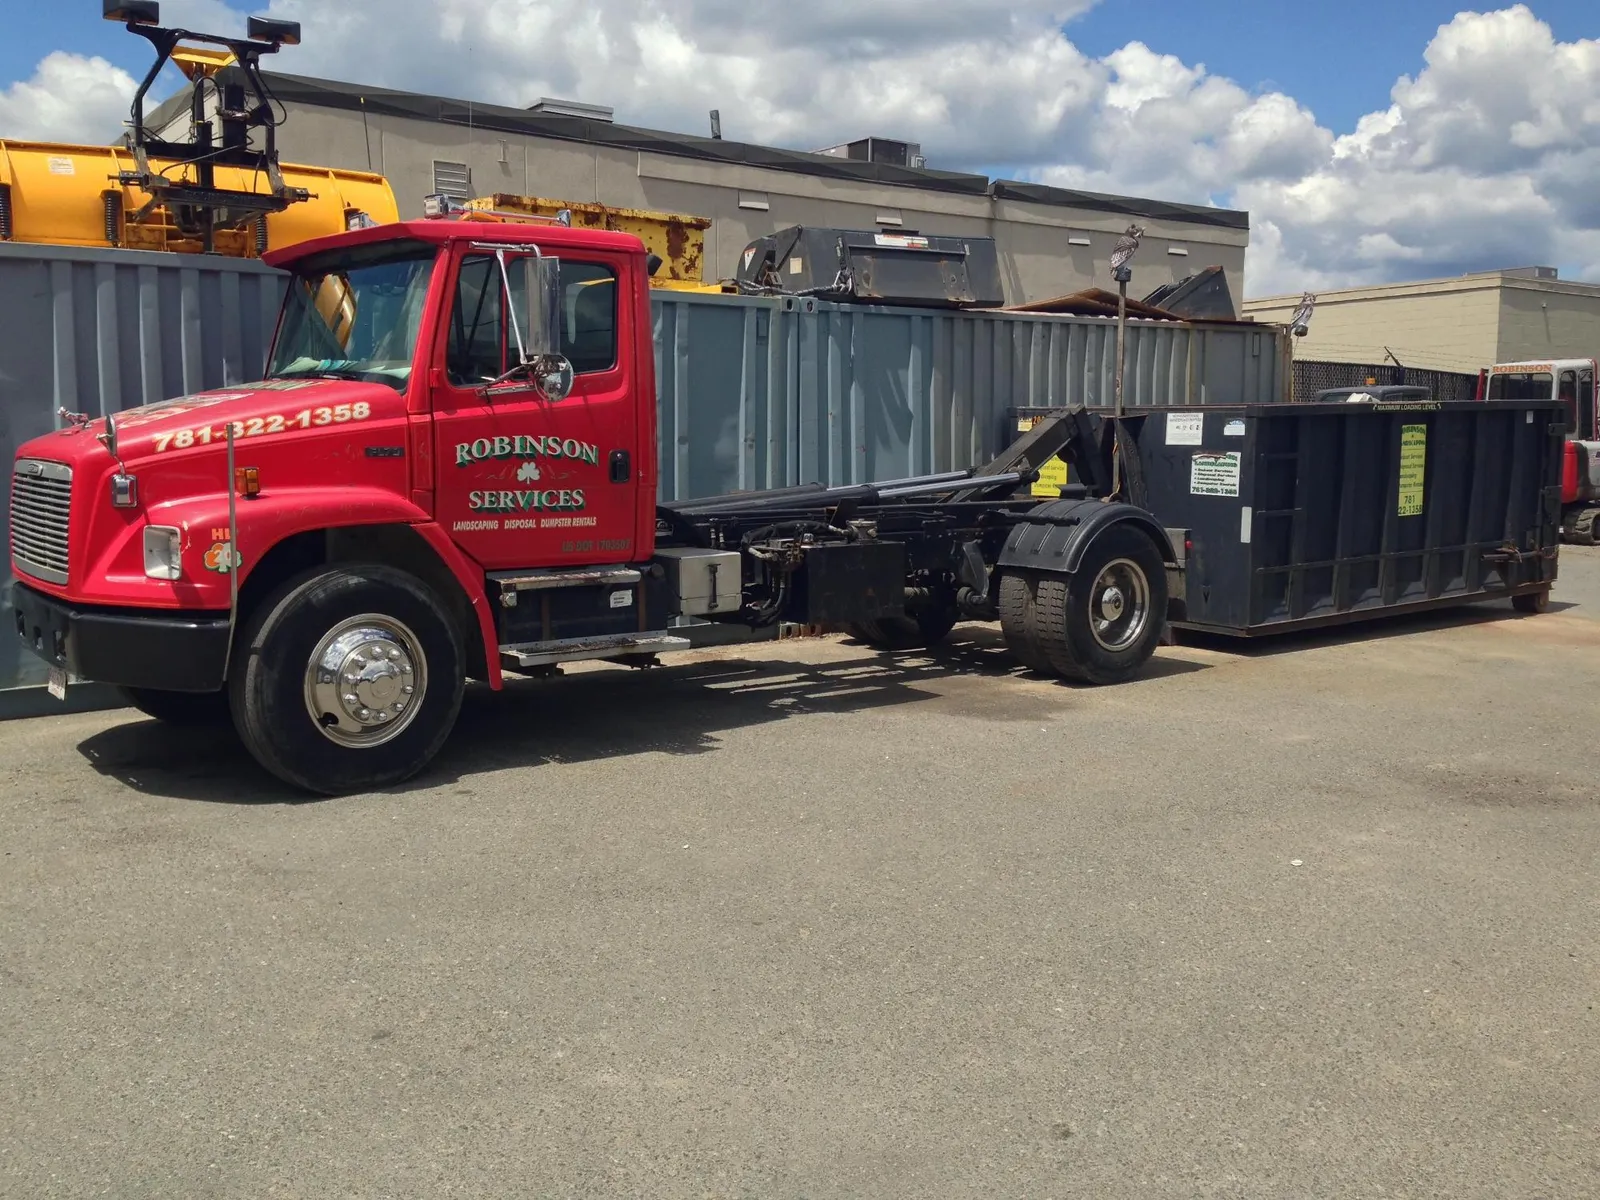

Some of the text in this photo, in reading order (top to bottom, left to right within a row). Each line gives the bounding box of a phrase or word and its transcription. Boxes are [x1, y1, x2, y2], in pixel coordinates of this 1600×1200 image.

[1493, 365, 1552, 373] ROBINSON
[151, 401, 371, 452] 781-322-1358
[455, 435, 598, 468] ROBINSON
[468, 489, 585, 514] SERVICES
[1404, 495, 1416, 504] 781
[453, 517, 597, 531] LANDSCAPING DISPOSAL DUMPSTER RENTALS
